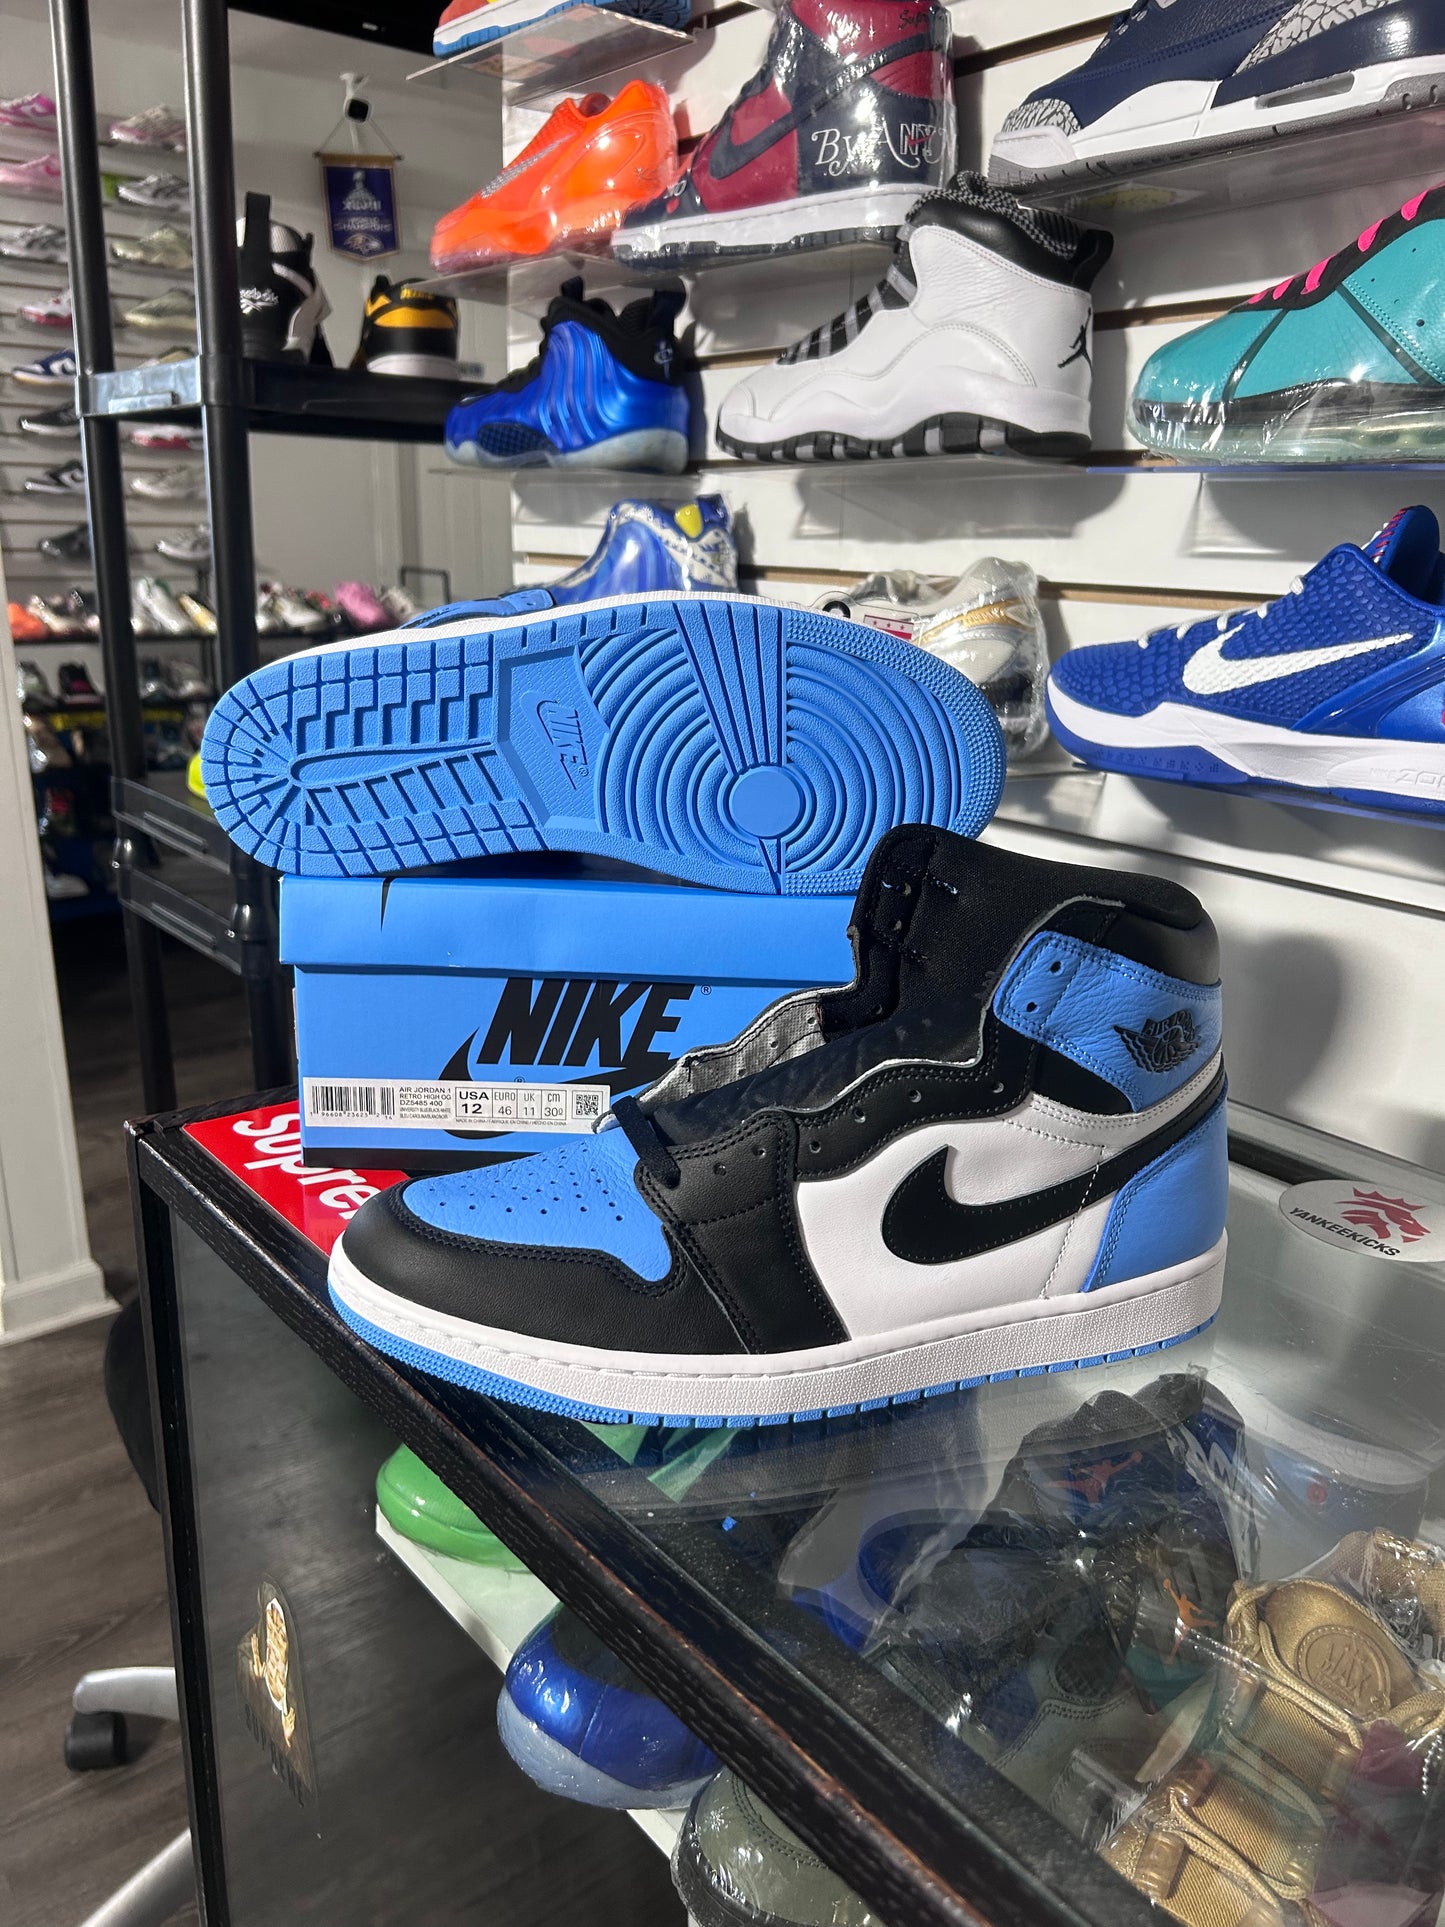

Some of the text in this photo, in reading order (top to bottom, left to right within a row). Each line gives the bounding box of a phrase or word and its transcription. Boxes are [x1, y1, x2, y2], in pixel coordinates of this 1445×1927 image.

[476, 977, 696, 1068] NIKE
[414, 1086, 446, 1094] JORDAN
[459, 1091, 489, 1101] USA
[494, 1092, 516, 1101] EURO
[523, 1093, 536, 1102] UK
[461, 1103, 483, 1114] 12
[498, 1106, 512, 1116] 46
[524, 1106, 535, 1117] 11
[232, 1112, 382, 1221] Supre
[1289, 1207, 1401, 1257] YANKEEKICKS
